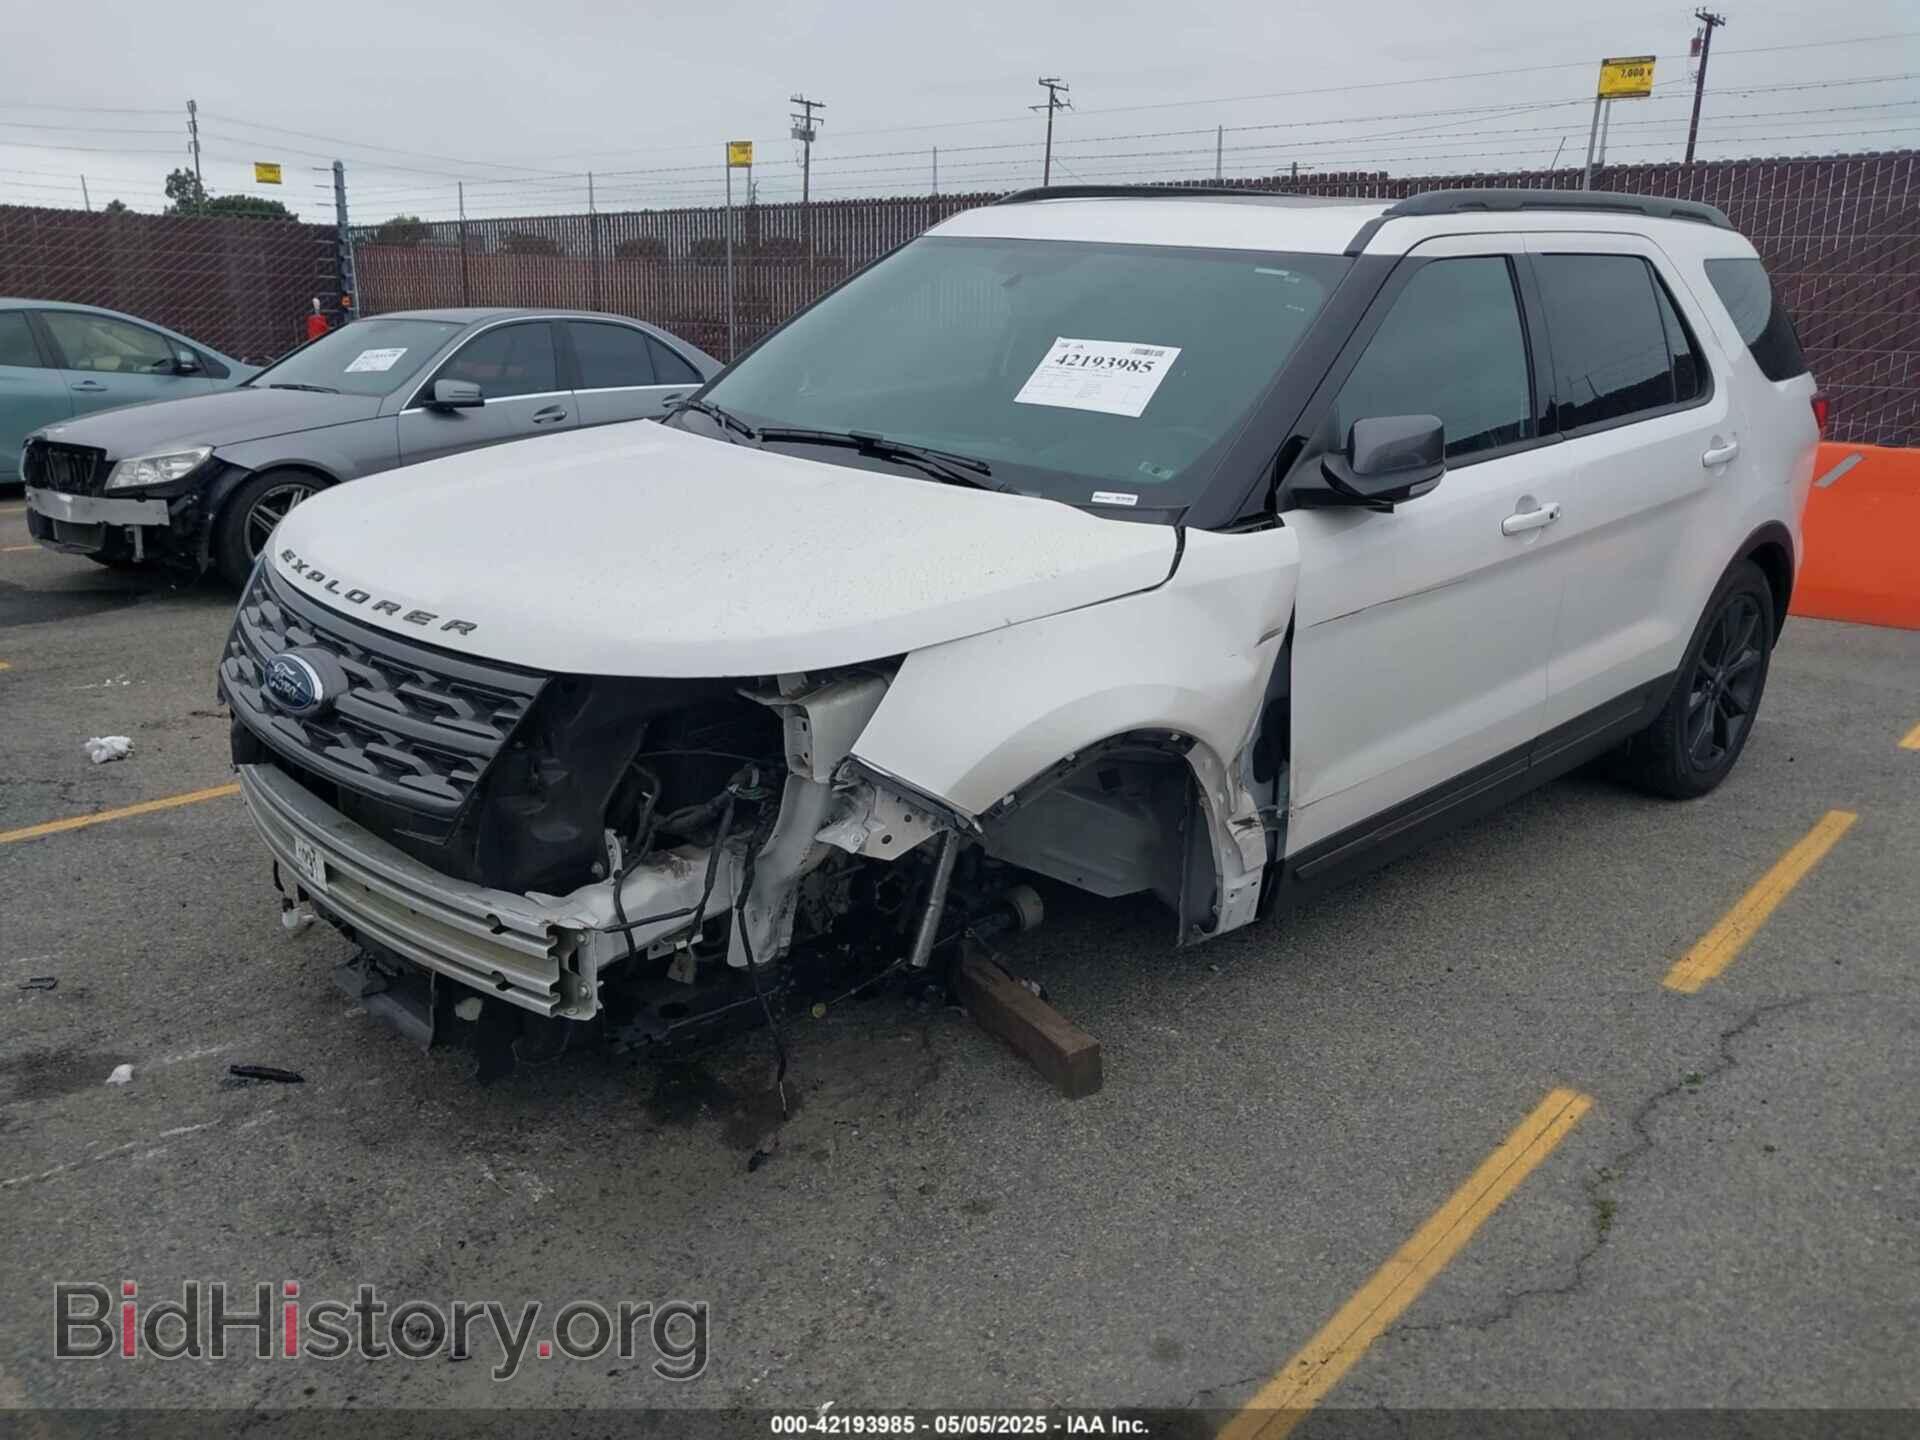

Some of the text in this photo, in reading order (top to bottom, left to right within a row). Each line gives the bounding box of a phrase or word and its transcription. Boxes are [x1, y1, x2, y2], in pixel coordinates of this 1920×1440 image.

[1055, 353, 1156, 374] 42193985
[280, 548, 479, 636] EXPLORER
[269, 662, 302, 697] Ford
